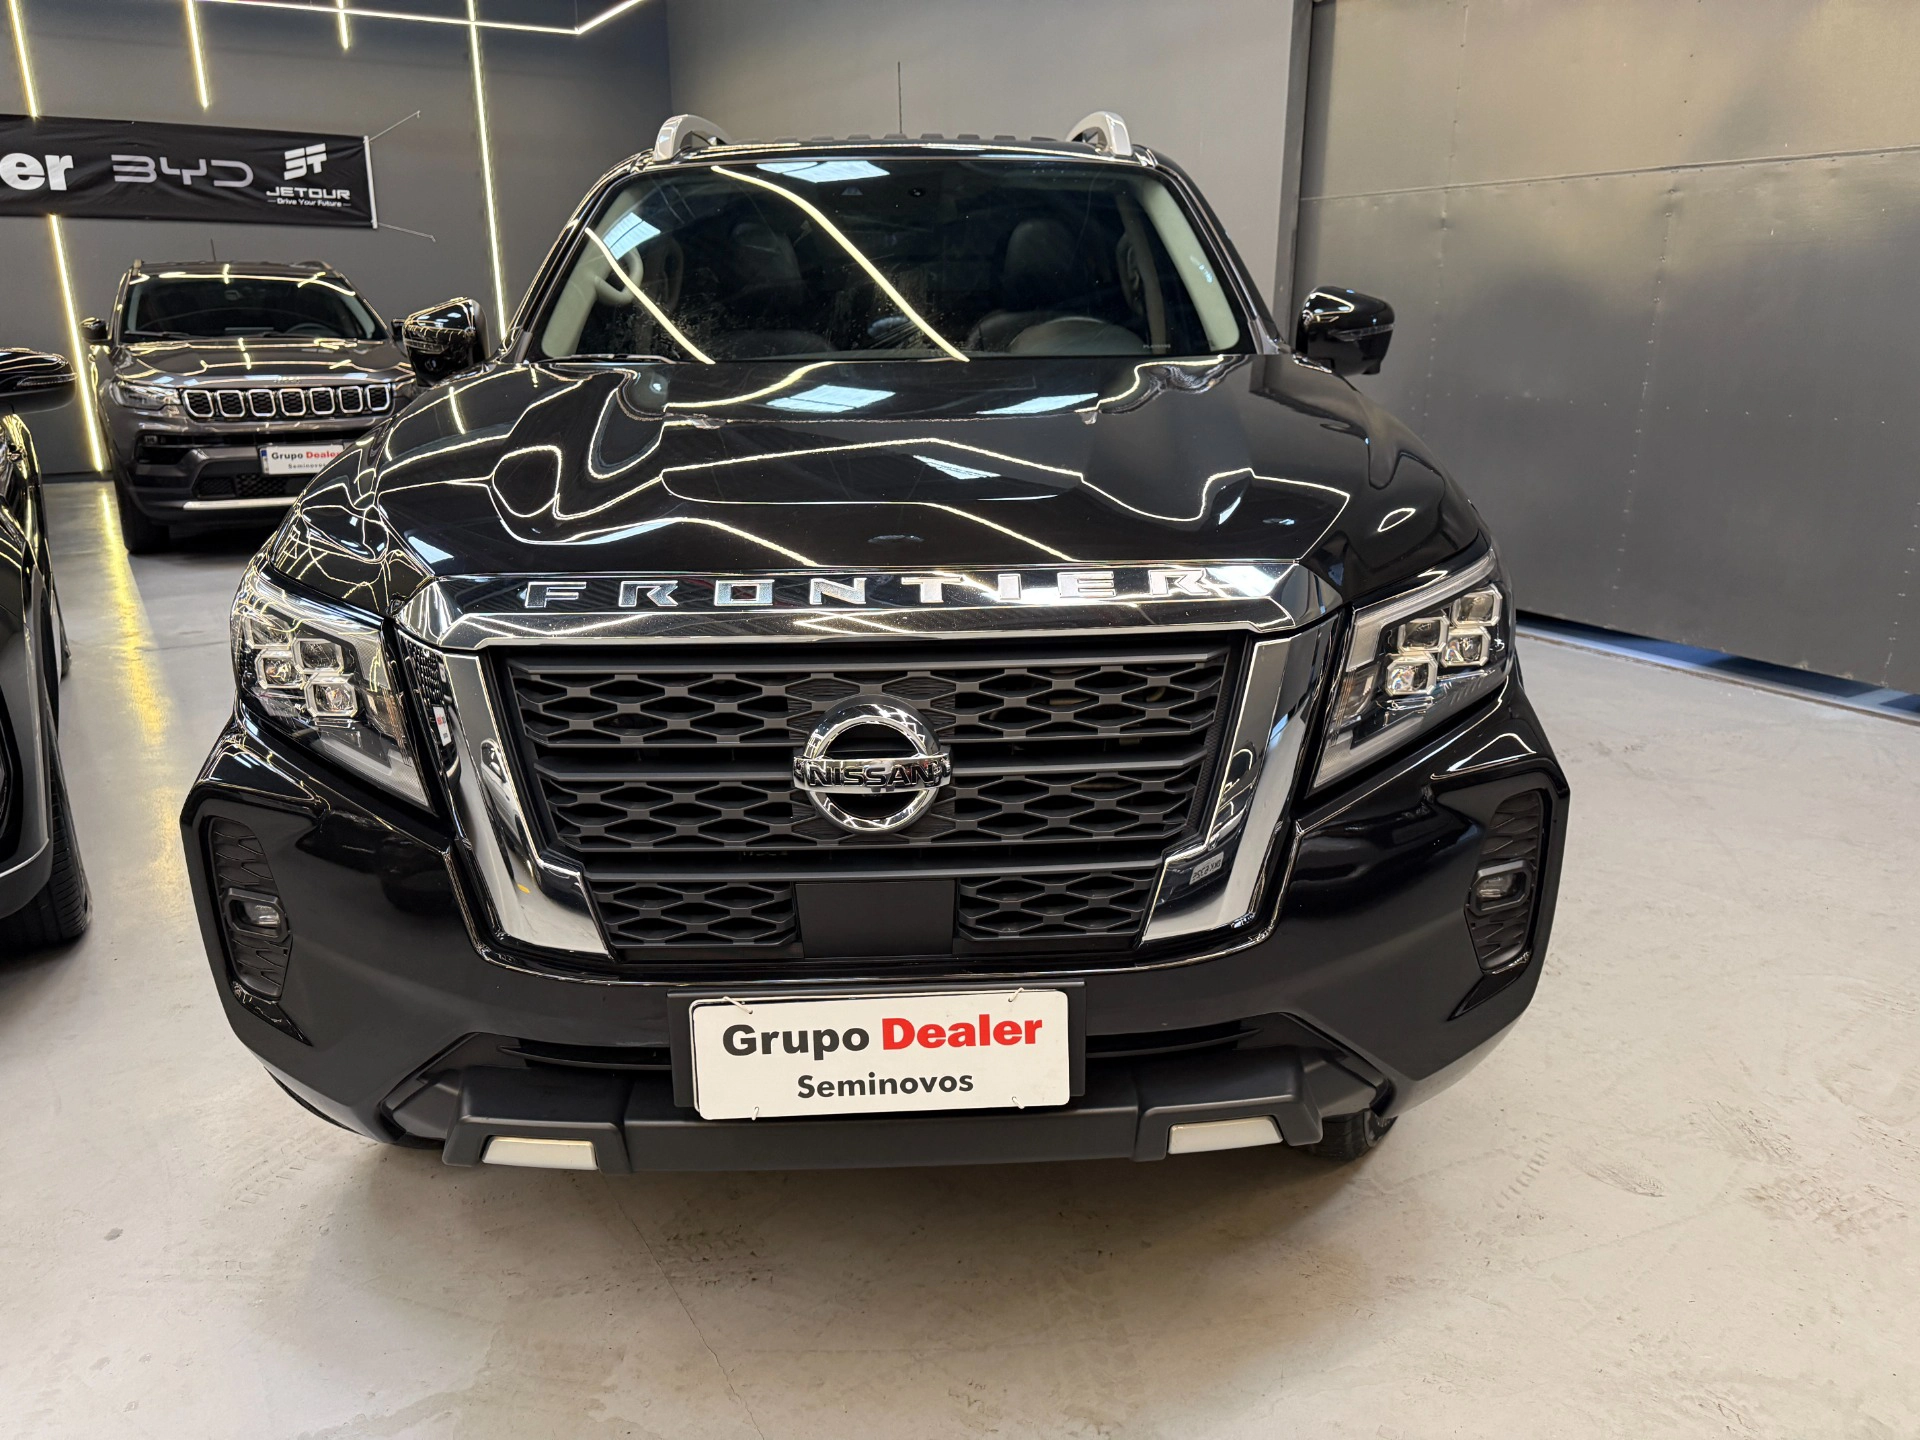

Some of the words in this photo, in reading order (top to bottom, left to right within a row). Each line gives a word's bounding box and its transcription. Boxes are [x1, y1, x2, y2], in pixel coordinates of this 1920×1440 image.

[110, 154, 254, 188] BYD
[265, 186, 351, 200] JETOUR
[276, 197, 298, 205] Drive
[298, 198, 317, 206] Your
[317, 199, 342, 207] Future
[271, 452, 304, 461] Grupo
[523, 569, 1210, 609] FRONTIER
[808, 764, 938, 788] NISSAN
[722, 1024, 870, 1061] Grupo
[881, 1013, 1043, 1050] Dealer
[797, 1072, 974, 1099] Seminovos
